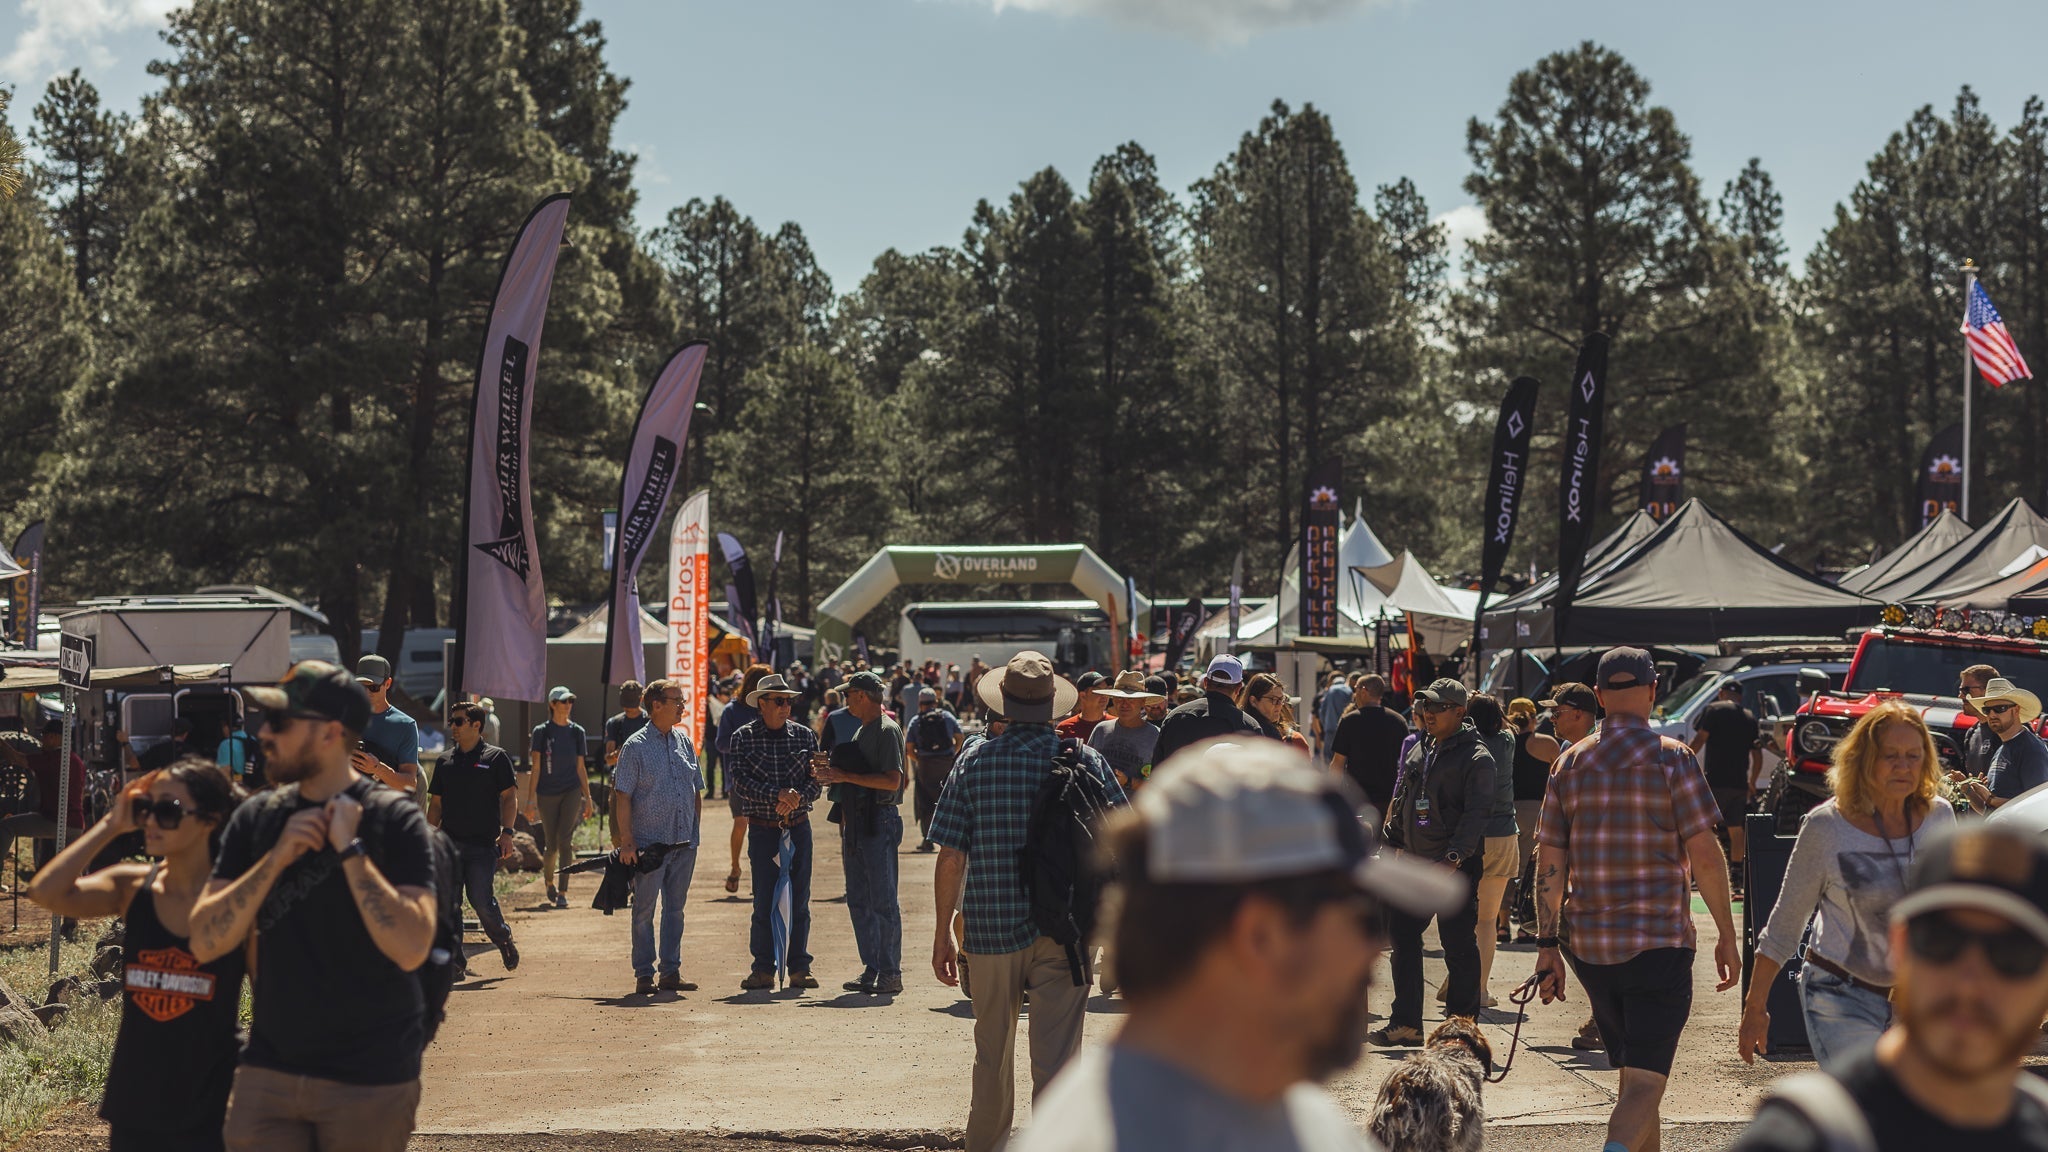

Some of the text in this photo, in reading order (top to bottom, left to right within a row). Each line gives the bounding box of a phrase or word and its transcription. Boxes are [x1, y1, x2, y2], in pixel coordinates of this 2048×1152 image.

[501, 354, 517, 445] WHEEL
[511, 452, 519, 502] POP-UP
[638, 450, 667, 512] WHEEL
[1567, 418, 1590, 523] Helinox
[1494, 450, 1519, 544] Helinox
[672, 555, 693, 610] Pros
[699, 560, 707, 590] more
[963, 557, 1037, 571] OVERLAND
[1307, 525, 1320, 590] GRID
[697, 593, 707, 603] &
[696, 605, 708, 655] Awnings
[62, 648, 71, 669] ONE
[696, 697, 707, 718] Top
